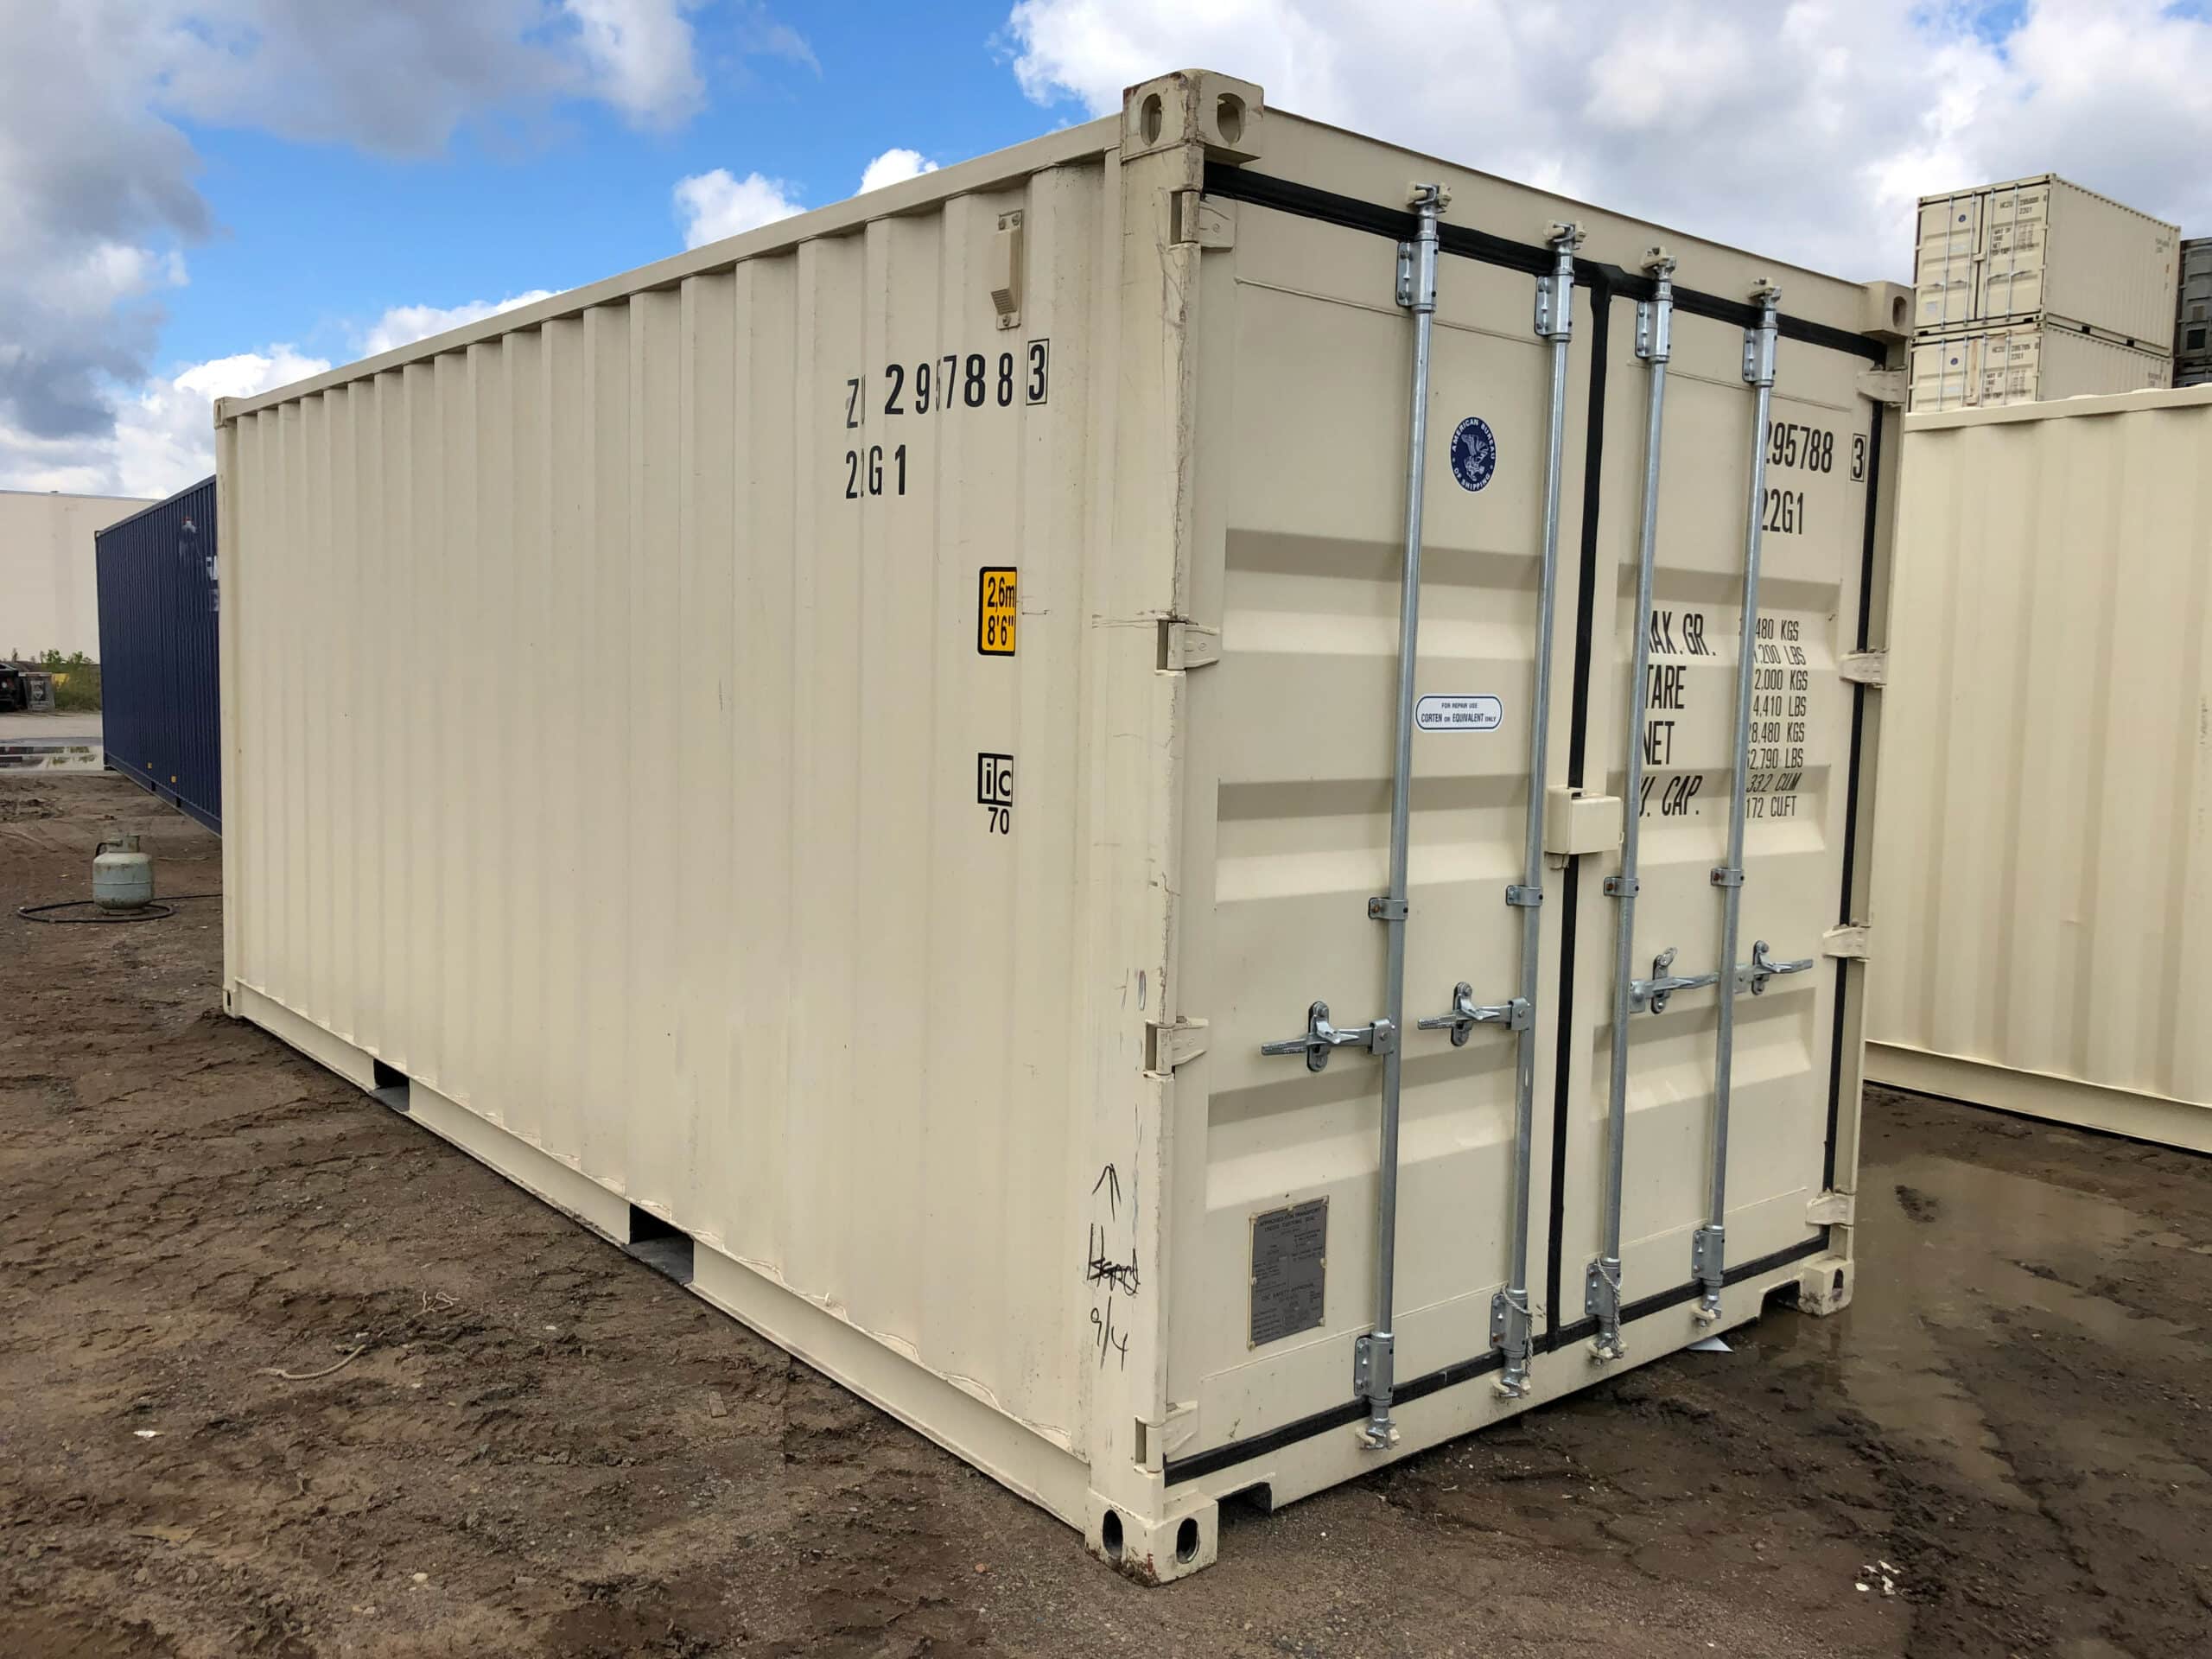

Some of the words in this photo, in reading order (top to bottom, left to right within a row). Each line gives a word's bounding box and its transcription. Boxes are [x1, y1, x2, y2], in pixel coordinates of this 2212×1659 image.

[1028, 343, 1046, 401] 3
[1452, 418, 1478, 452] AMERICAN
[1480, 423, 1496, 460] BUREAU
[1853, 437, 1865, 479] 3
[1453, 467, 1462, 479] OF
[1461, 473, 1491, 491] SHIPPING
[987, 576, 1014, 613] 2,6m
[1649, 610, 1683, 655] AX.
[1682, 613, 1716, 656] GR.
[1781, 619, 1799, 642] KGS
[1783, 645, 1806, 665] LBS
[1645, 664, 1688, 709] TARE
[1789, 670, 1808, 691] KGS
[1421, 713, 1442, 722] CORTEN
[1452, 713, 1484, 722] EQUIVALENT
[1753, 695, 1783, 718] 4,410
[1788, 696, 1807, 717] LBS
[1787, 721, 1805, 743] KGS
[1784, 747, 1803, 769] LBS
[1662, 775, 1703, 817] CAP.
[988, 806, 1009, 835] 70
[1090, 1295, 1128, 1372] 9/4
